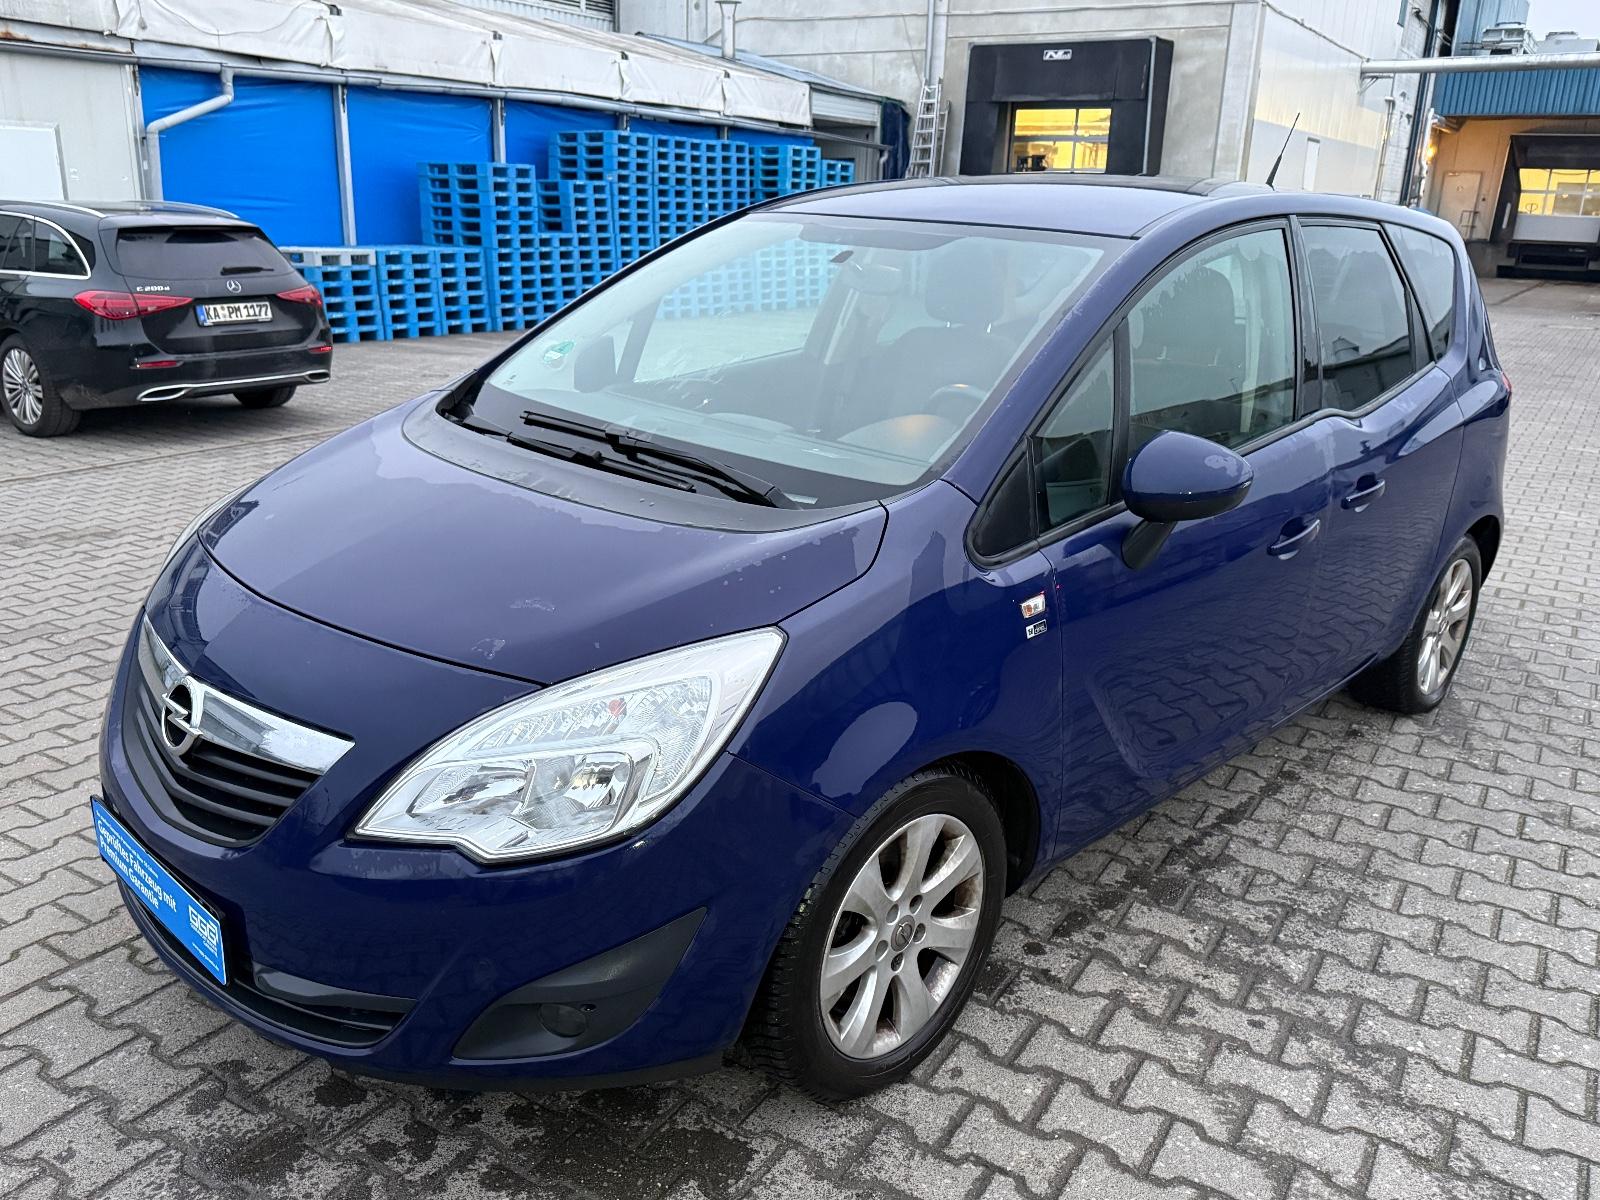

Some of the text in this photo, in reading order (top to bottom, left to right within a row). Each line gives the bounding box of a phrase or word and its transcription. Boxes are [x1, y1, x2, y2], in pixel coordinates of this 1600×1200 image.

[205, 303, 269, 321] KA PM 1177
[97, 820, 130, 862] Geprüftes
[129, 853, 163, 899] Fahrzeug
[163, 891, 177, 913] mit
[99, 835, 129, 876] Premium
[128, 868, 160, 910] Garantie
